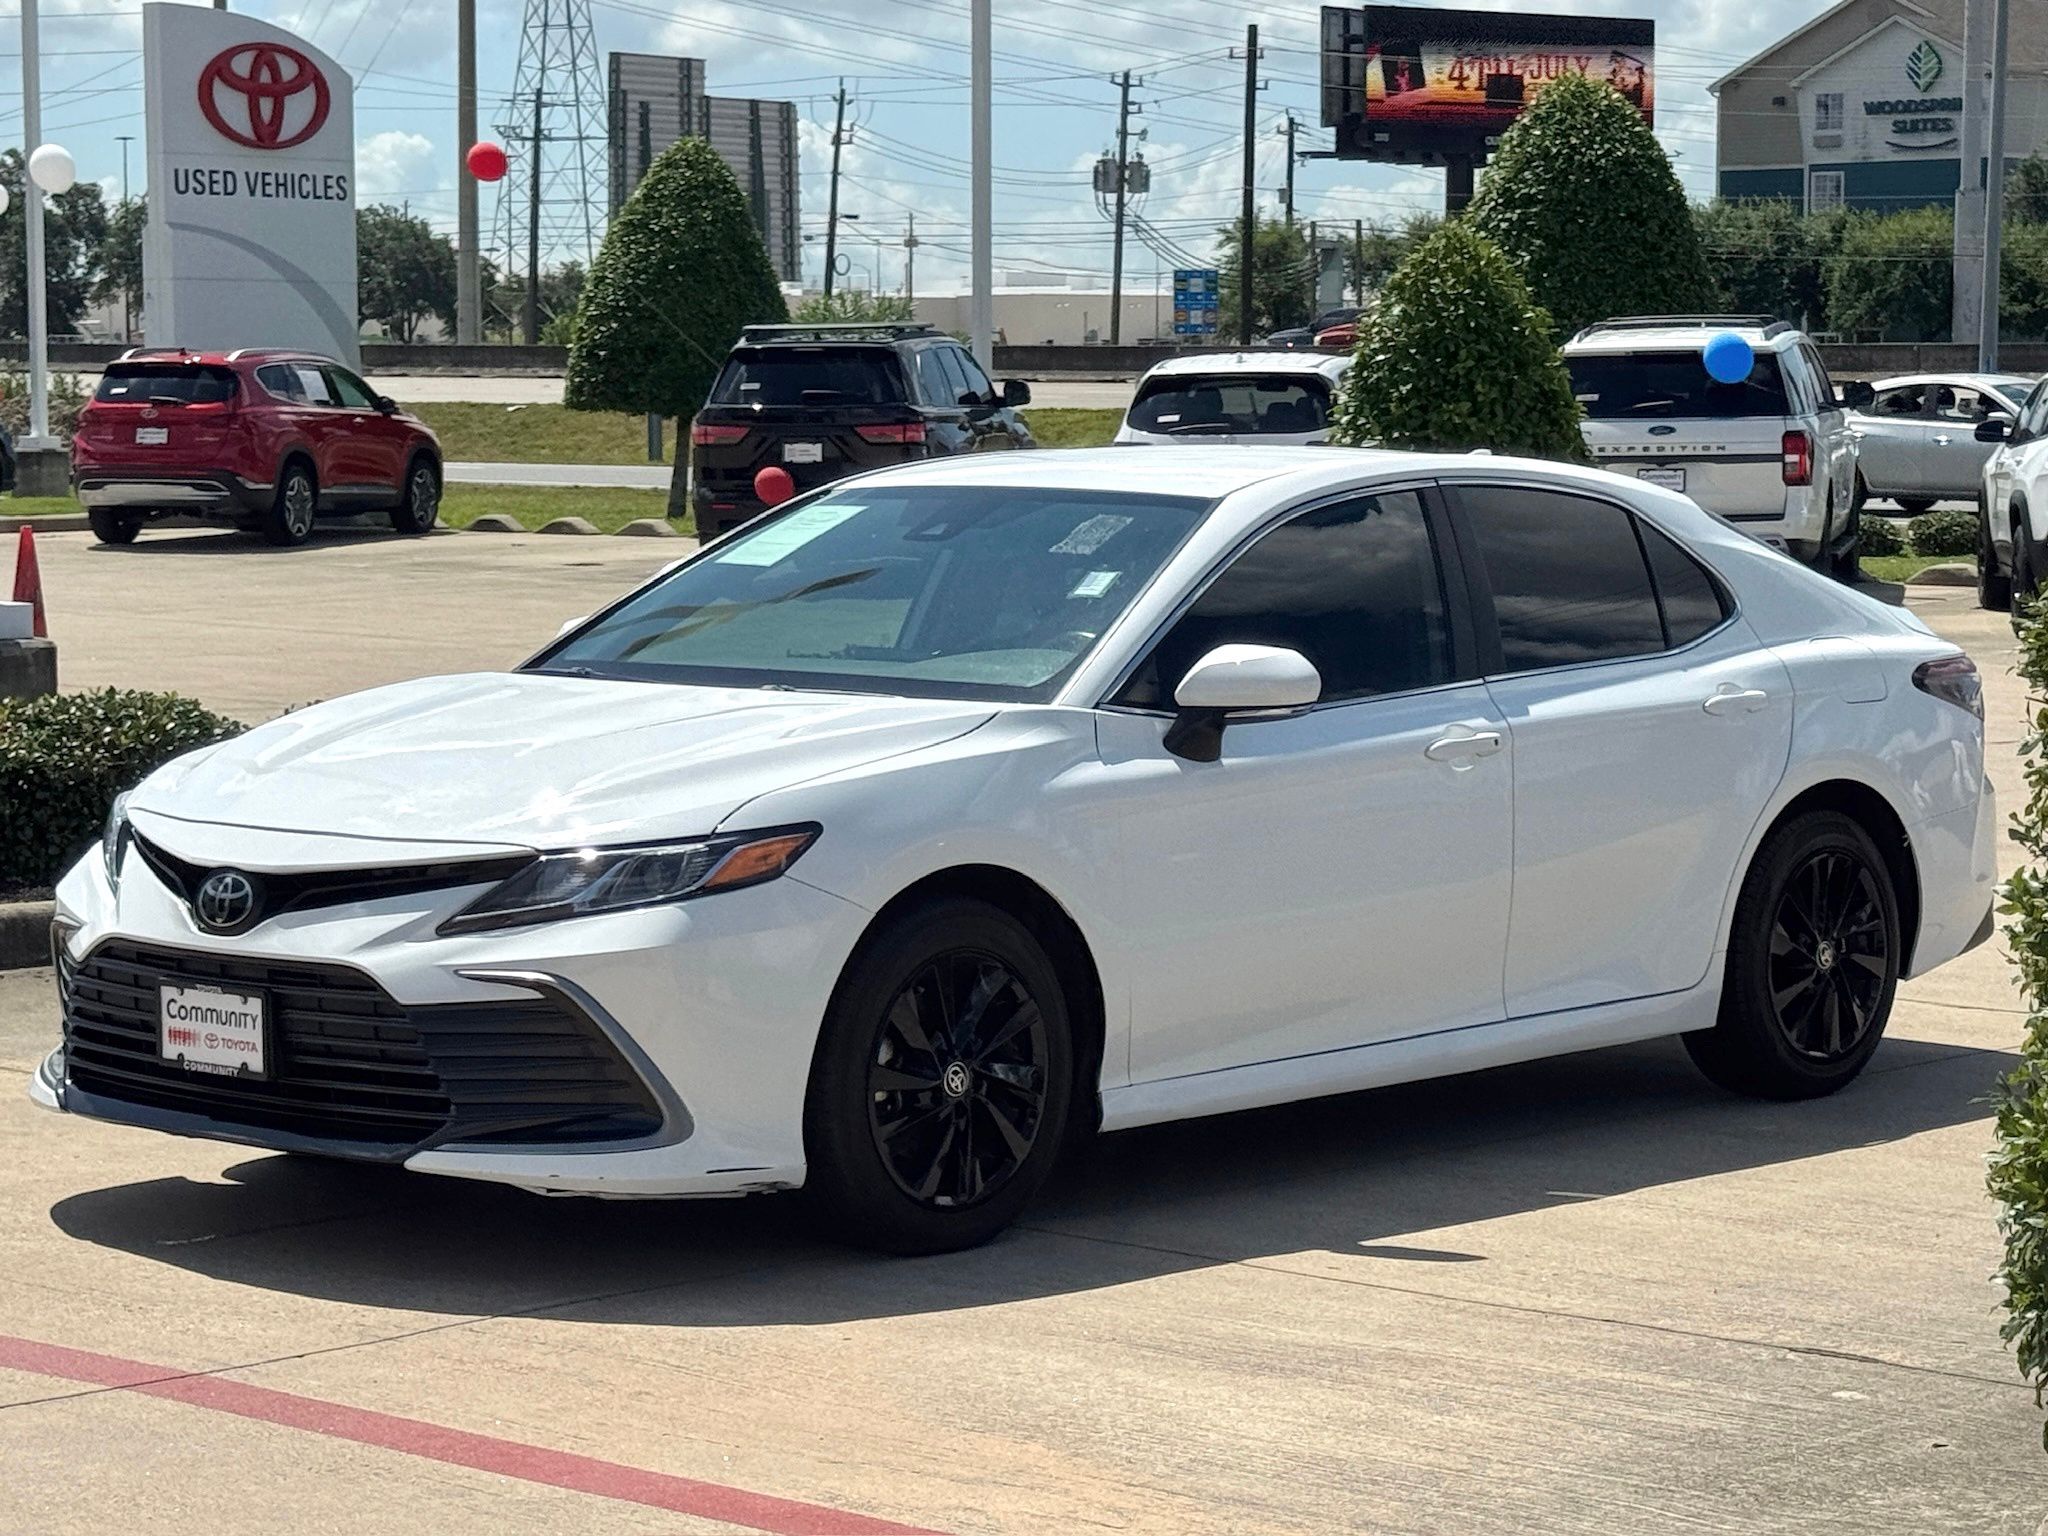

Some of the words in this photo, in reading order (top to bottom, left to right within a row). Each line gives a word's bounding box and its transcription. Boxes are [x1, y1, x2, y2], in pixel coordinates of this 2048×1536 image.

[1863, 97, 1963, 115] WOODSPRI
[1891, 117, 1954, 134] SUITES
[174, 168, 238, 196] USED
[244, 170, 348, 201] VEHICLES
[1597, 445, 1727, 453] EXPEDITION
[221, 1037, 259, 1053] TOYOTA
[183, 1060, 240, 1078] COMMUNITY
